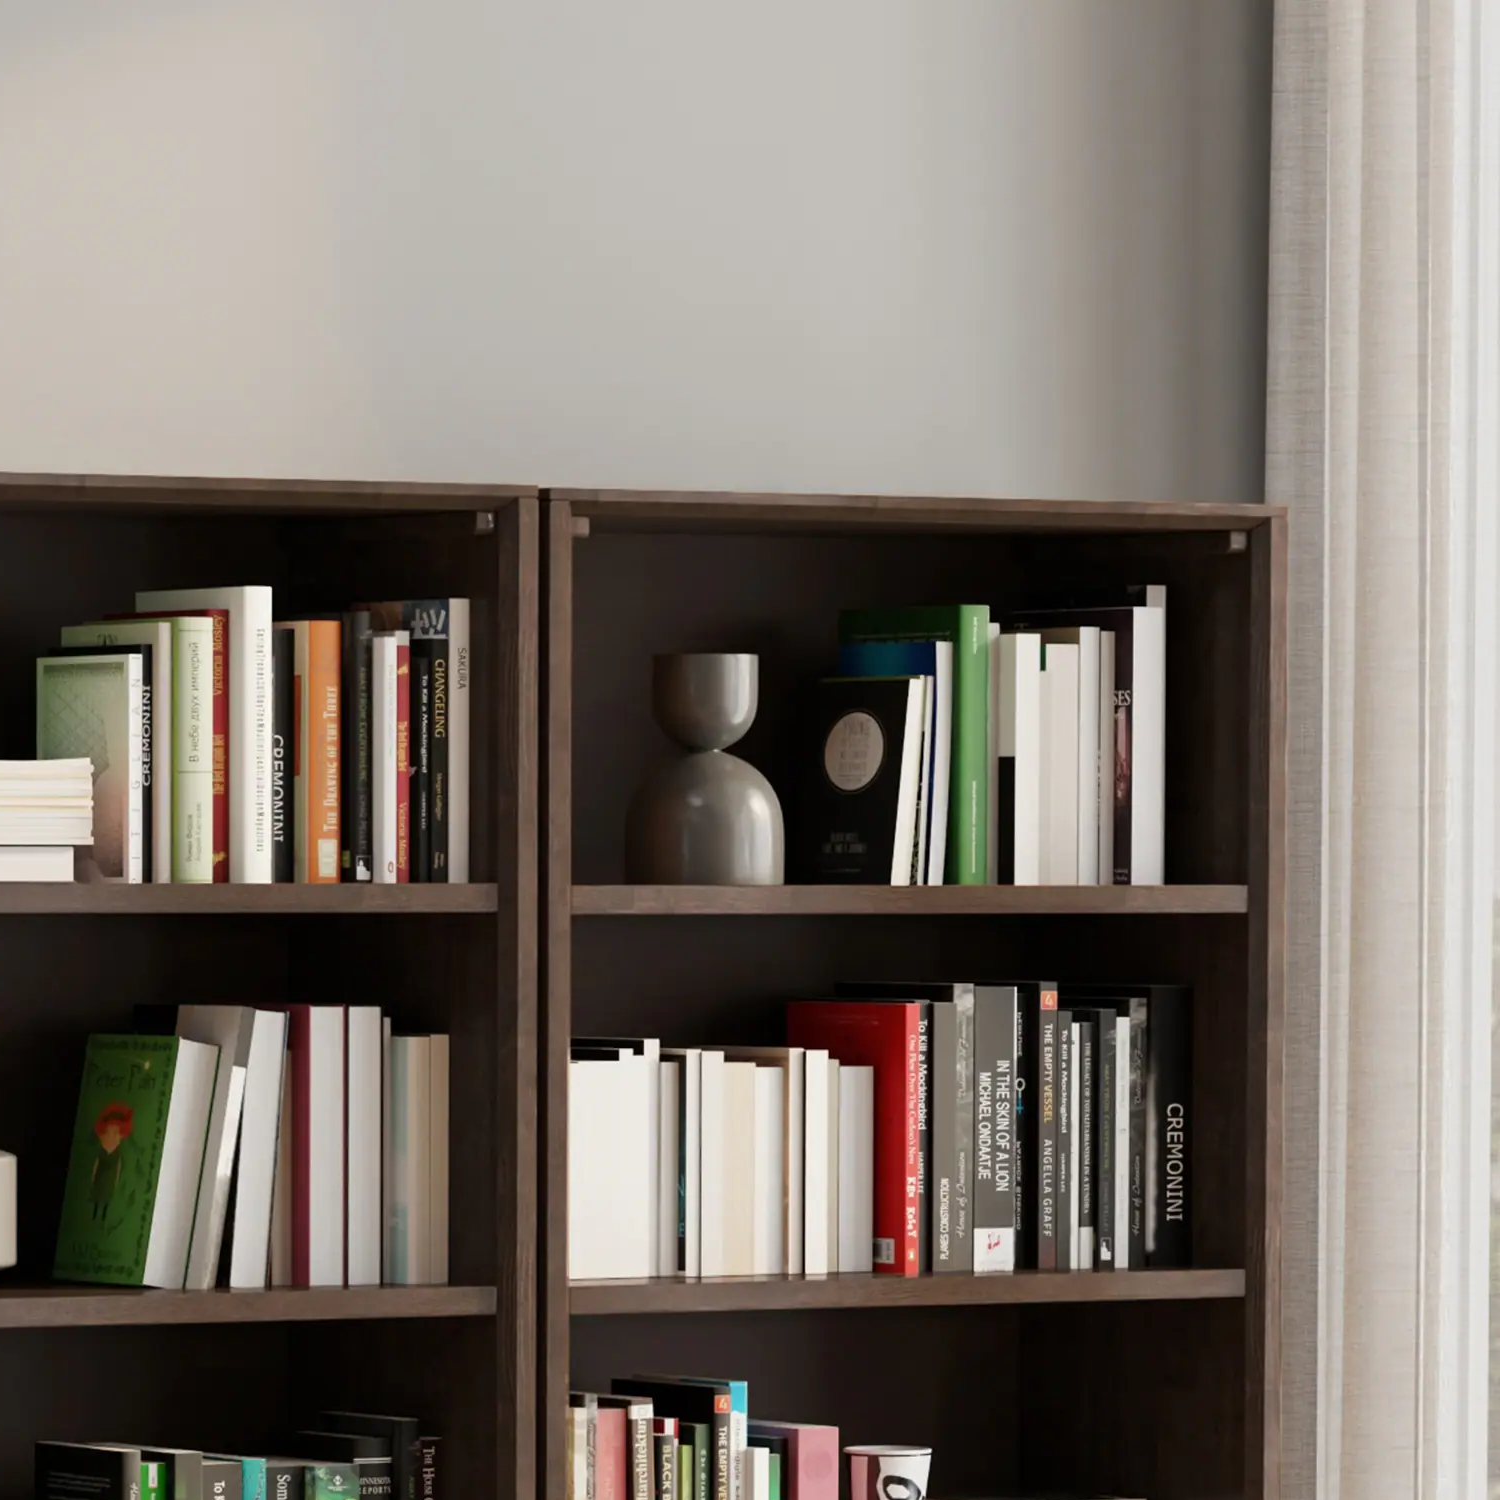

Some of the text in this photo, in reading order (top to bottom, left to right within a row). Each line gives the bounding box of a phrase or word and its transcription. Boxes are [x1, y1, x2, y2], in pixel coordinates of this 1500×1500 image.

[435, 659, 445, 738] CHANGELING
[457, 647, 466, 689] SAKURA
[142, 684, 151, 786] CREMONINI
[918, 1019, 928, 1032] To
[918, 1036, 927, 1052] Kill
[1061, 1029, 1068, 1041] To
[918, 1064, 927, 1130] Mockingbird
[1044, 1024, 1053, 1123] THE EMPTY VESSEL
[1060, 1071, 1068, 1133] Mockingbird
[978, 1072, 991, 1179] MICHAEL ONDAATJE
[996, 1060, 1009, 1191] IN THE SKIN OF A LION
[1043, 1139, 1052, 1237] ANGELLA GRAFF
[1166, 1103, 1183, 1221] CREMONINI
[662, 1445, 672, 1489] BLACK
[718, 1426, 727, 1447] THE
[718, 1449, 727, 1481] EMPTY
[214, 1481, 225, 1493] To
